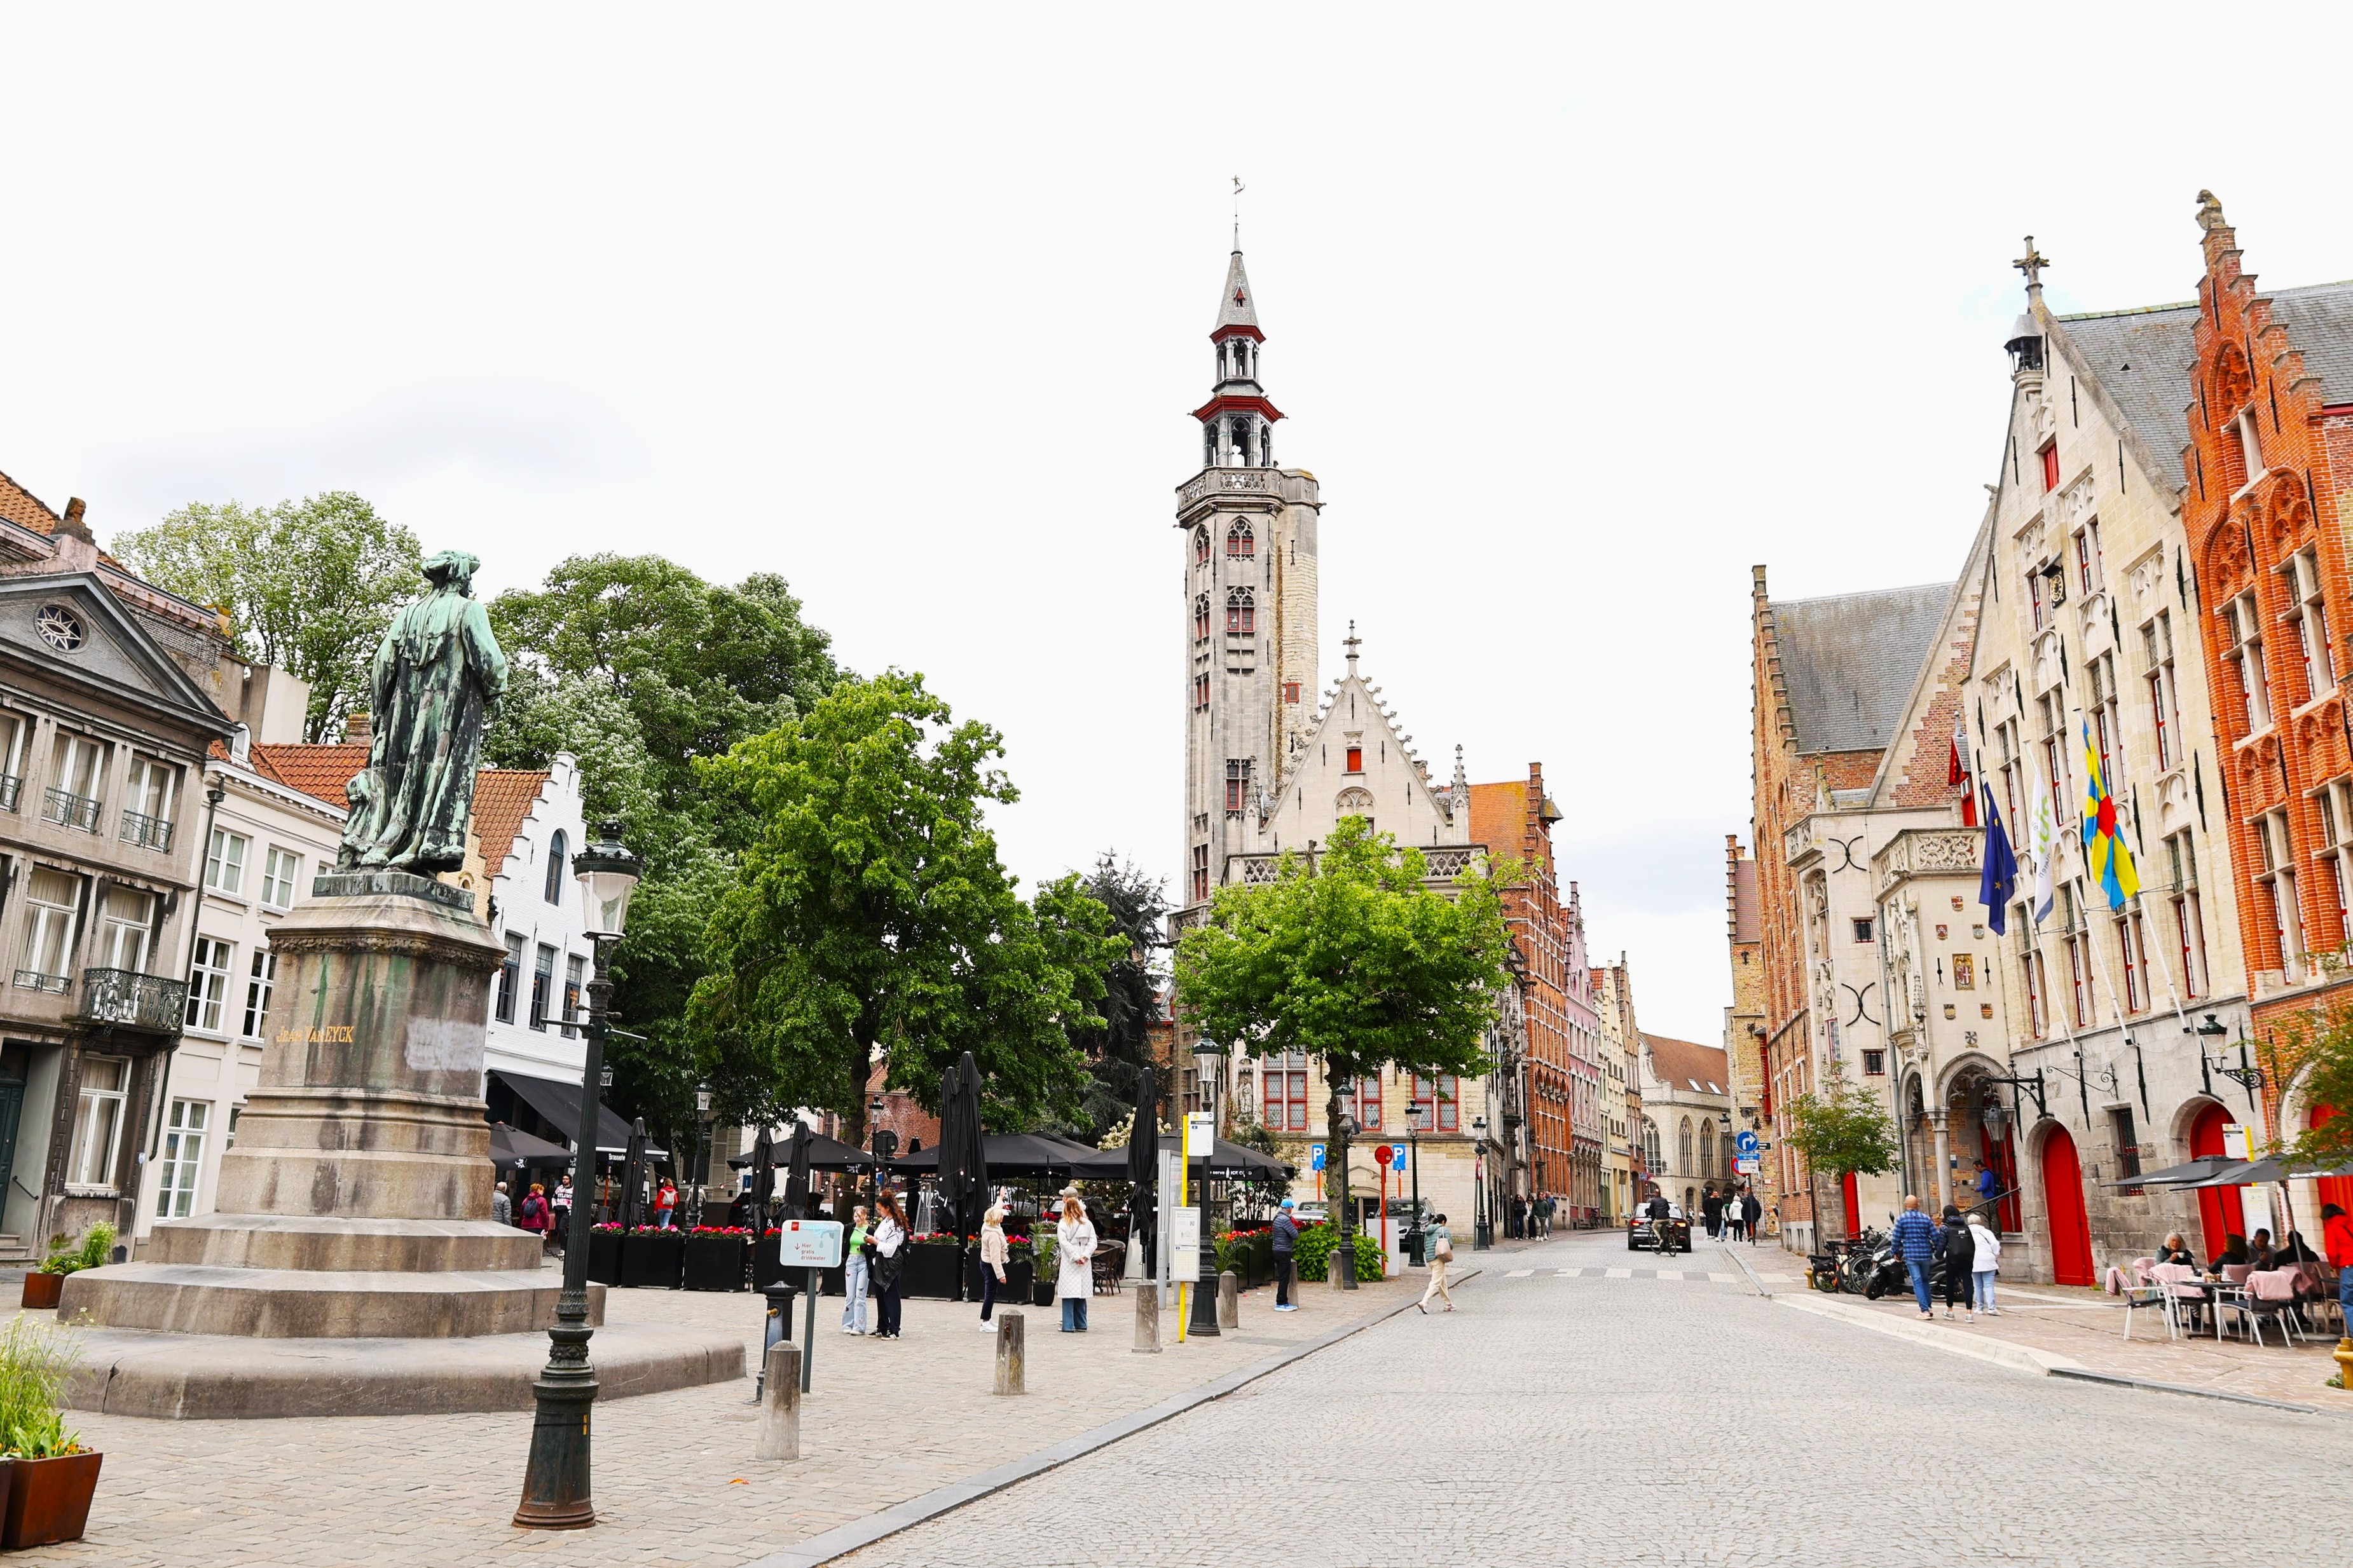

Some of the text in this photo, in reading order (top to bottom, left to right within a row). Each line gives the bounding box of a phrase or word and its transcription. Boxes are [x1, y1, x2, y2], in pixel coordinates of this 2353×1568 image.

[324, 1026, 354, 1042] EYCK
[608, 1153, 626, 1161] Brasserie
[1313, 1147, 1323, 1161] P
[1394, 1147, 1404, 1161] P
